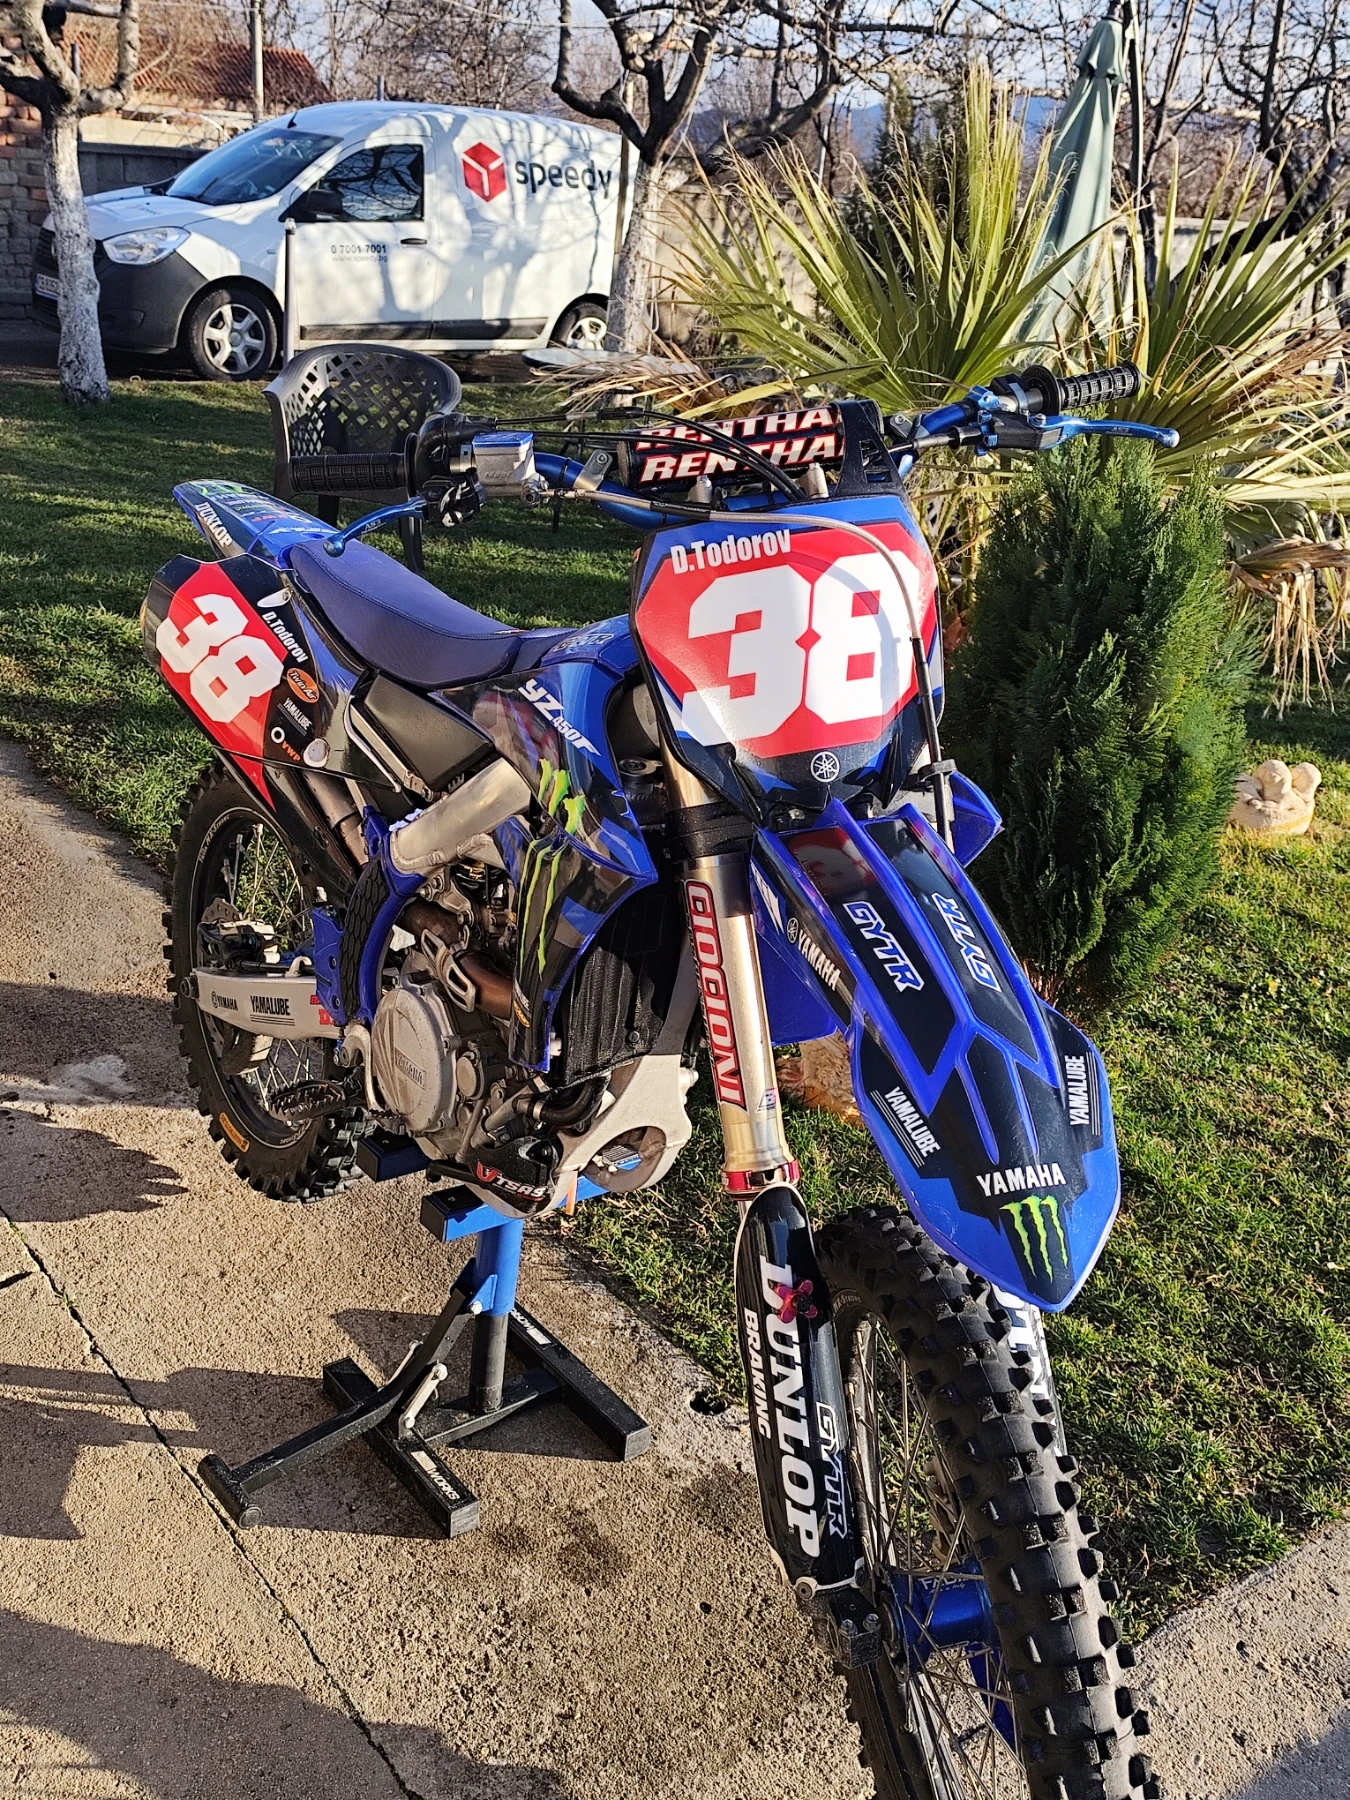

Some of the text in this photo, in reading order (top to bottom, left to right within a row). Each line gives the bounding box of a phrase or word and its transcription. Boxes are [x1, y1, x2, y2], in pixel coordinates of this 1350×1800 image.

[515, 160, 612, 199] speedy
[339, 244, 362, 254] 7001
[365, 244, 387, 253] 7001
[636, 408, 842, 451] RENTHA
[640, 433, 845, 484] RENTHA
[195, 502, 233, 548] DUNLOP
[670, 528, 791, 575] D.Todorov
[156, 594, 284, 723] 38
[262, 611, 309, 663] D.Todorov
[681, 550, 921, 747] 38
[282, 697, 313, 732] YAMALUBE
[798, 928, 842, 992] YAMAHA
[842, 901, 925, 993] GYTR
[217, 995, 238, 1011] YAMAHA
[250, 995, 290, 1016] YAMALUBE
[1064, 1055, 1090, 1126] YAMALUBE
[884, 1086, 941, 1157] YAMALUBE
[976, 1162, 1067, 1197] YAMAHA
[744, 1307, 771, 1440] BRAKING
[760, 1255, 820, 1558] DUNLOP
[427, 1468, 461, 1500] WORKS
[816, 1401, 847, 1540] GYTR
